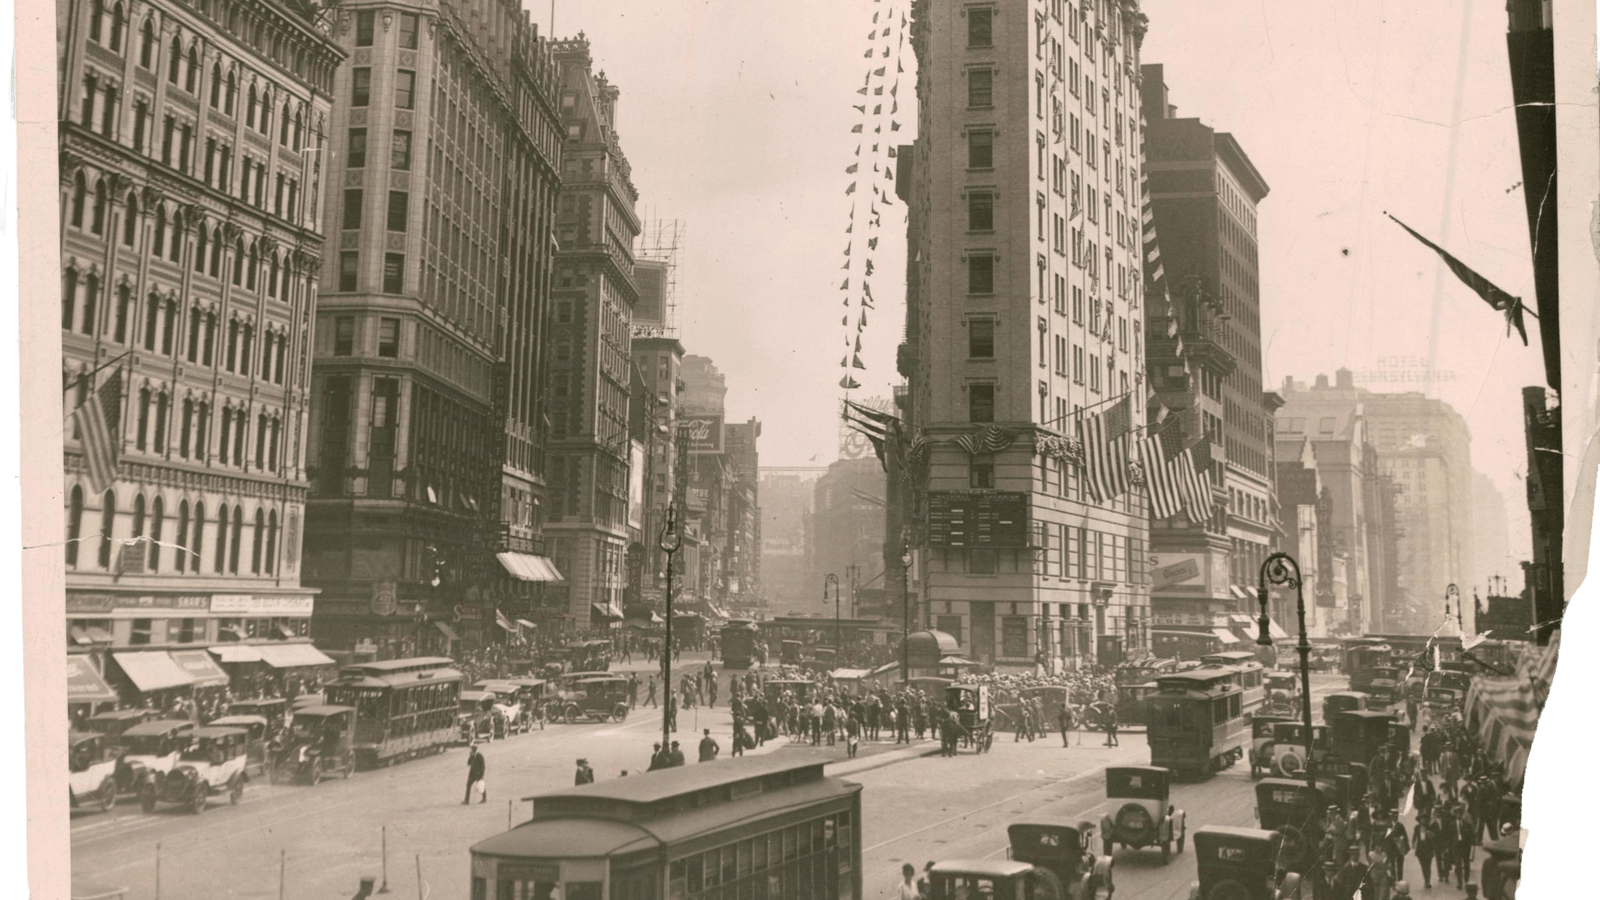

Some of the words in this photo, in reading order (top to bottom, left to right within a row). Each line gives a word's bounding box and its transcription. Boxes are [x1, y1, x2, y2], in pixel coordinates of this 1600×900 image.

[1377, 355, 1430, 368] HOTEL
[1352, 369, 1458, 383] PENNSYLVANIA
[688, 419, 715, 440] Cola
